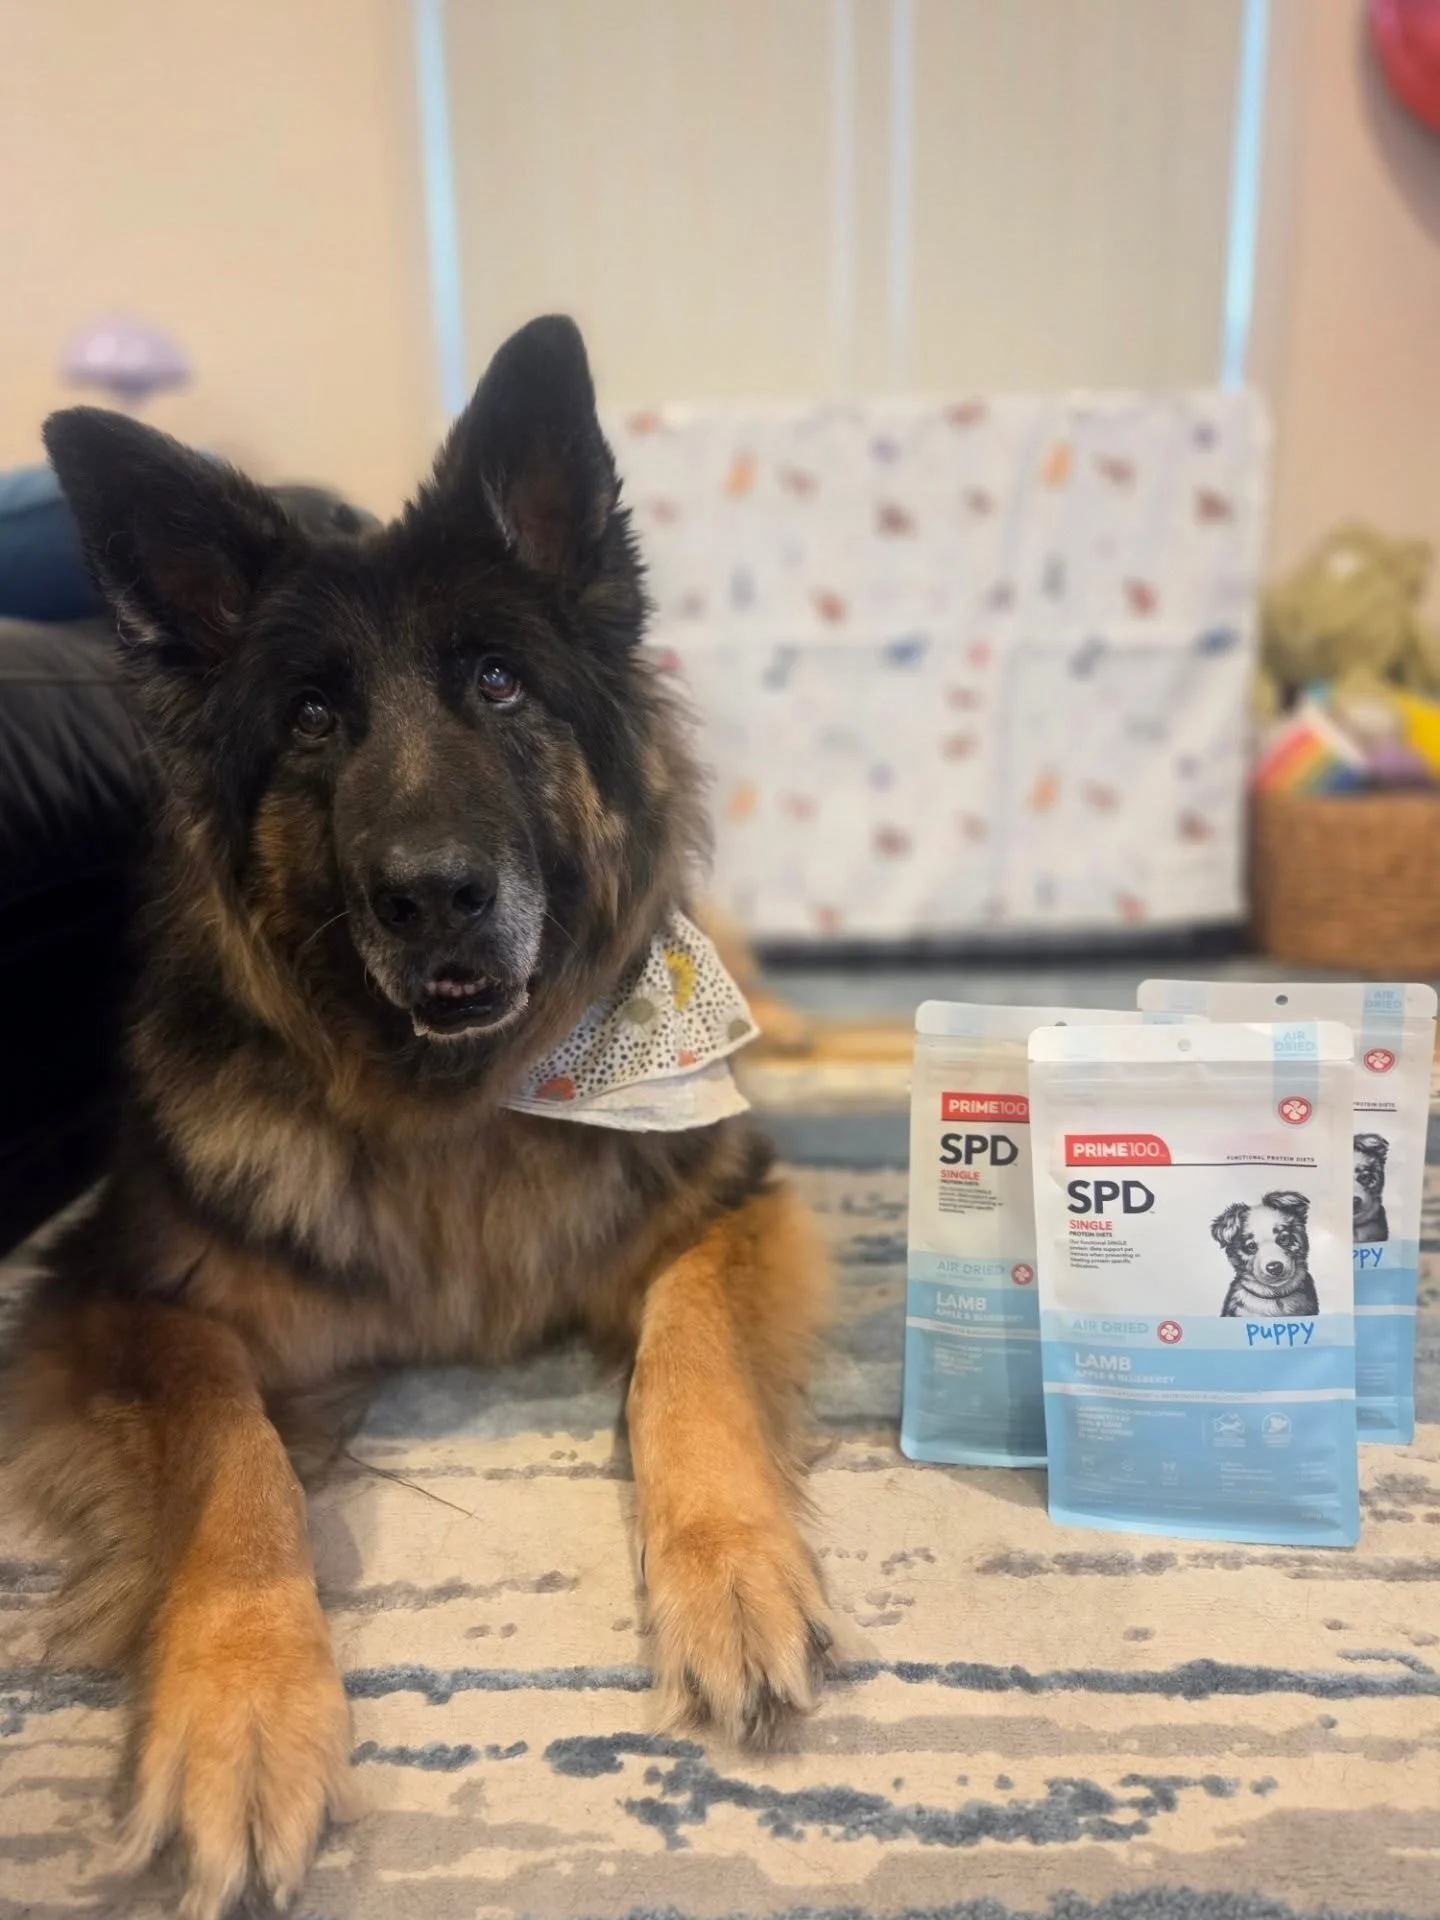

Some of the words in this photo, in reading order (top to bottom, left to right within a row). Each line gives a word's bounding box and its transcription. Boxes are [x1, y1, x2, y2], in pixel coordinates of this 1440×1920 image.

[1282, 1031, 1305, 1040] AIR
[1274, 1041, 1316, 1052] DRIED
[948, 1100, 1028, 1115] PRIME100
[939, 1133, 1019, 1166] SPD
[1073, 1142, 1160, 1157] PRIME100
[940, 1169, 980, 1180] SINGLE
[1067, 1180, 1155, 1214] SPD
[1069, 1220, 1113, 1231] SINGLE
[937, 1261, 960, 1273] AIR
[937, 1291, 987, 1311] LAMB
[1073, 1319, 1098, 1332] AIR
[1101, 1321, 1149, 1334] DRIED
[1246, 1322, 1315, 1346] puppy
[1075, 1352, 1132, 1371] LAMB
